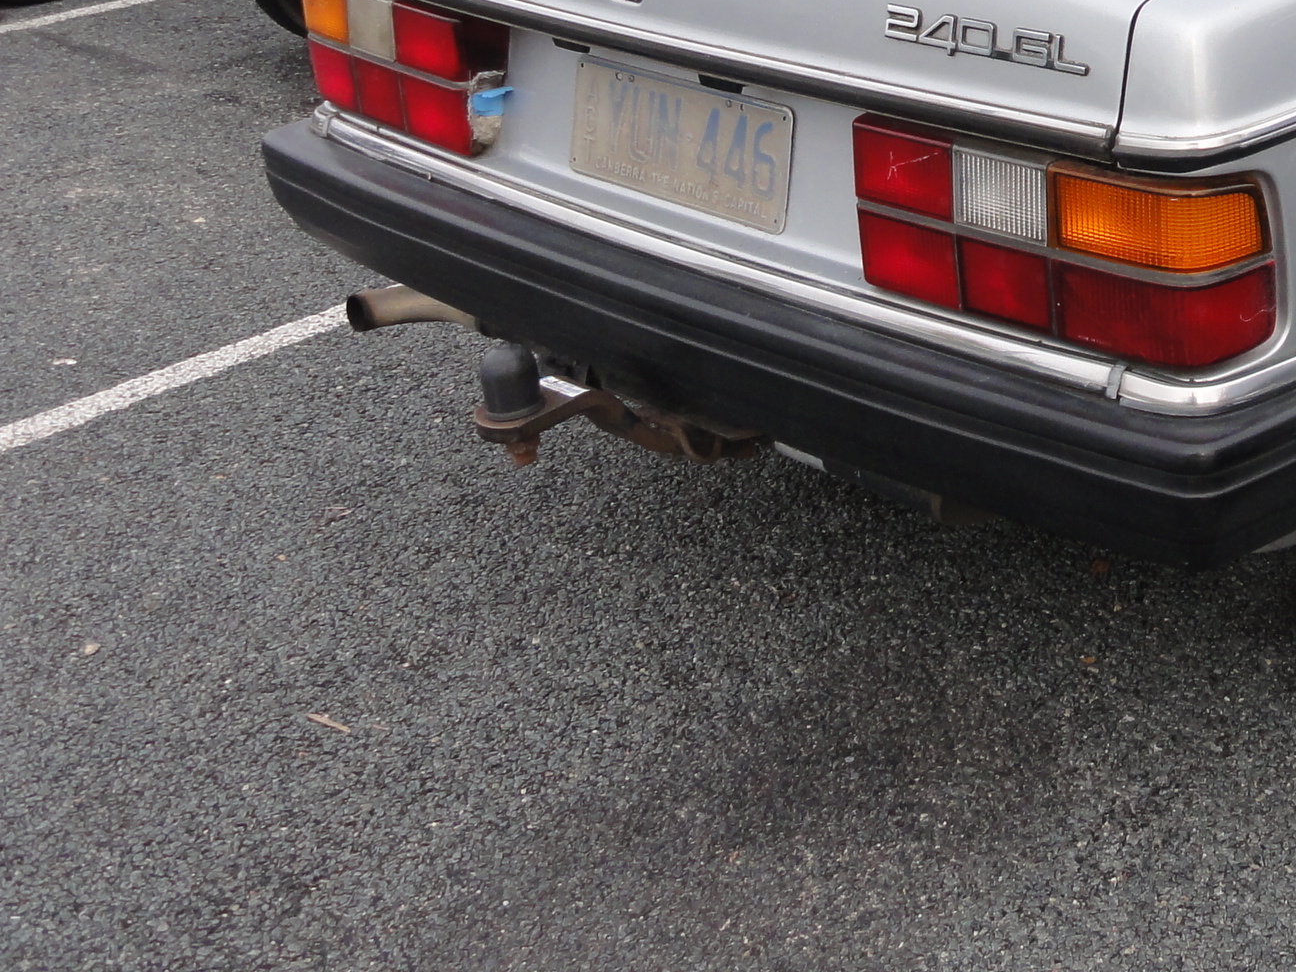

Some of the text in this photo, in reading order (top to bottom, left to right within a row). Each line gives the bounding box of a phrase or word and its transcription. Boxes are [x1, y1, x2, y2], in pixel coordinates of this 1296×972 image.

[884, 2, 1090, 77] 240 GL
[696, 107, 776, 202] 446
